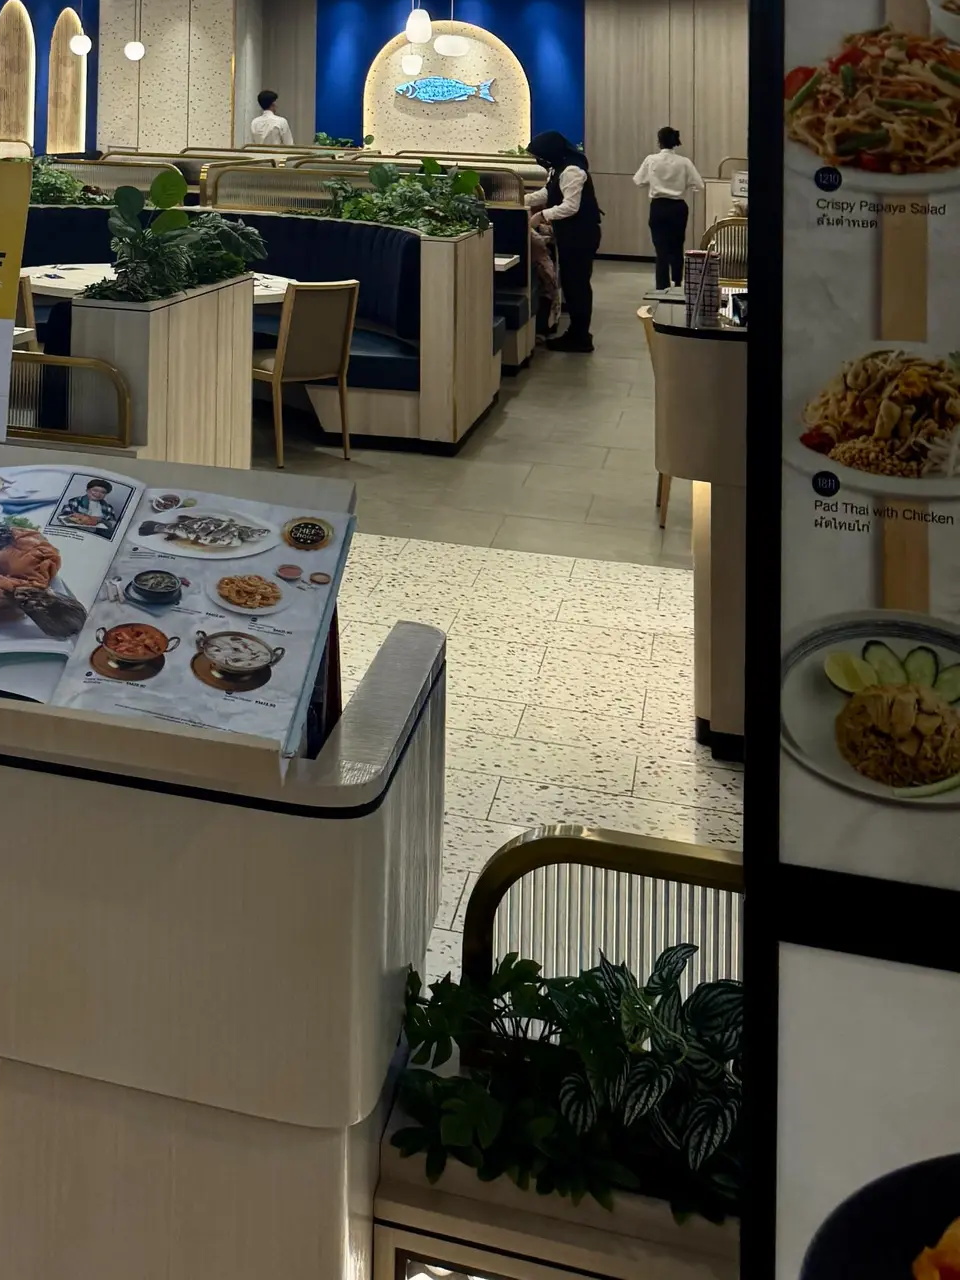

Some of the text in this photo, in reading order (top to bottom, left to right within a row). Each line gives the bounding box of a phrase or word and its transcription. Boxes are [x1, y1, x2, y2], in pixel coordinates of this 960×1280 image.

[815, 198, 947, 216] Crispy Papaya Salad
[814, 499, 955, 525] Pad Thai with Chicken
